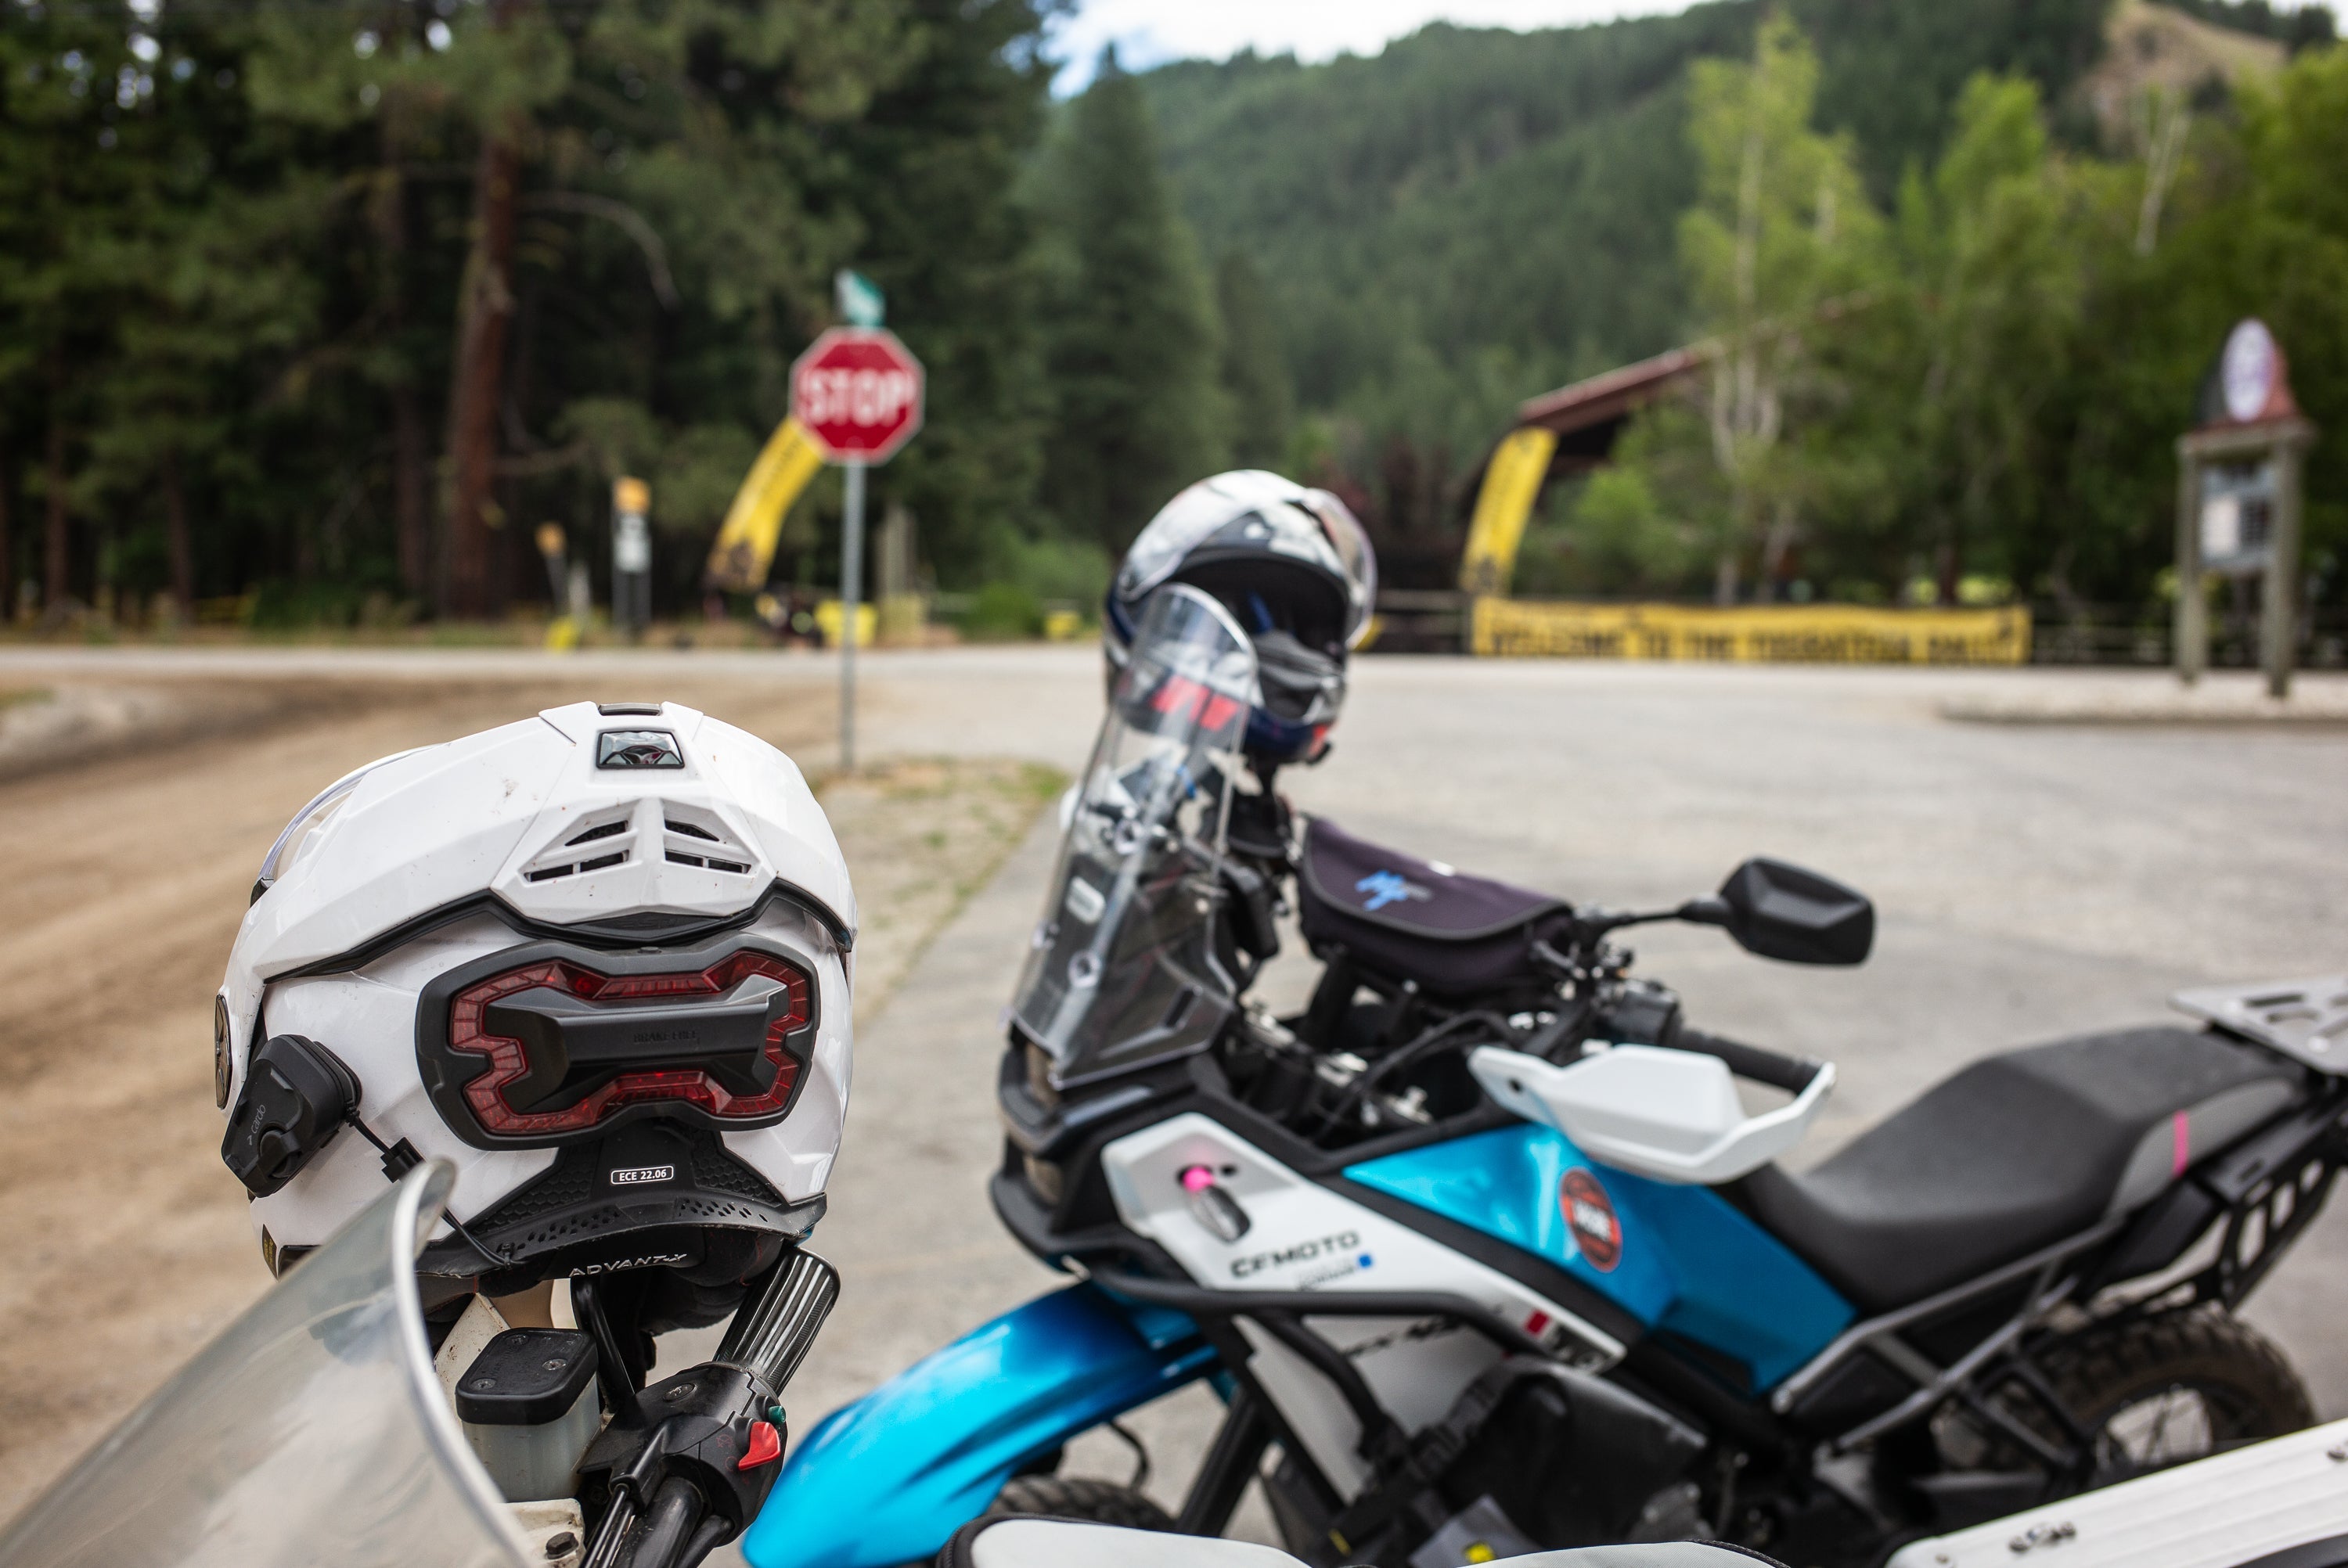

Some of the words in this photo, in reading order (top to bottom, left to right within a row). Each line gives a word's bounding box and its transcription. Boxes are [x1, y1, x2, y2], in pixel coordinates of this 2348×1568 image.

[799, 369, 917, 426] STOP
[250, 1104, 266, 1134] cardo
[619, 1172, 638, 1181] ECE
[640, 1168, 668, 1180] 22.06
[1230, 1230, 1361, 1279] CFMOTO
